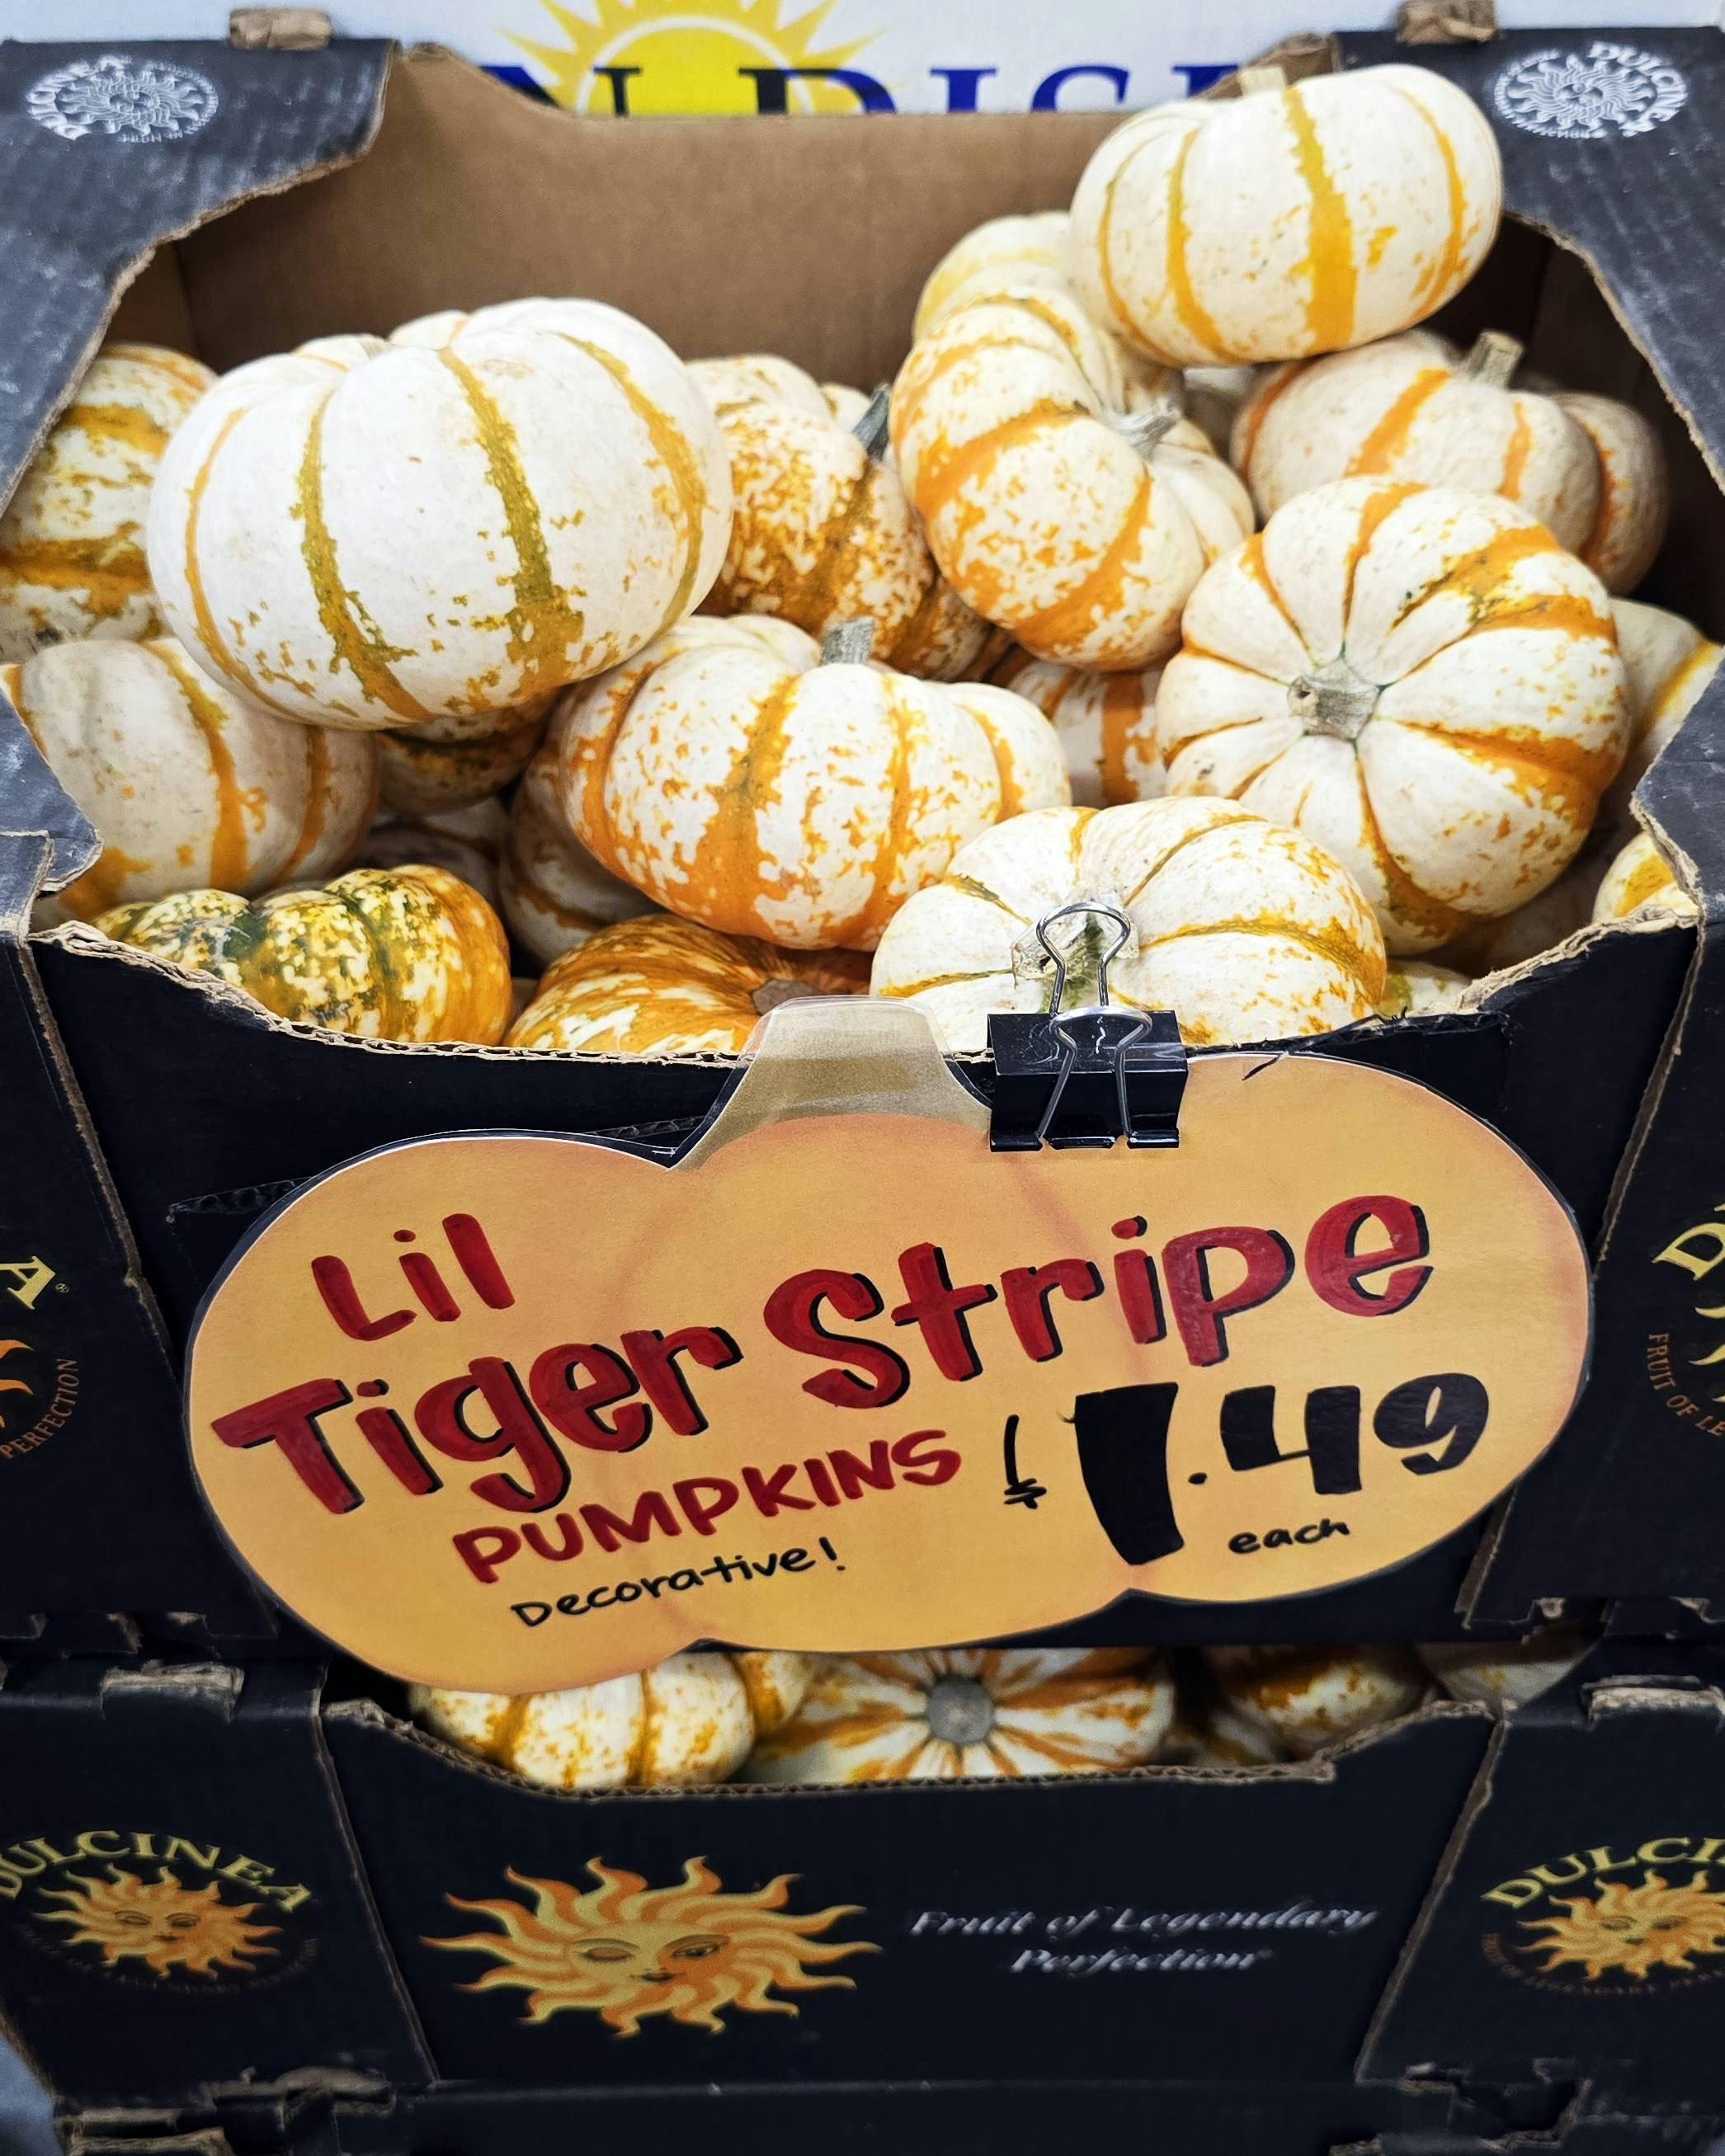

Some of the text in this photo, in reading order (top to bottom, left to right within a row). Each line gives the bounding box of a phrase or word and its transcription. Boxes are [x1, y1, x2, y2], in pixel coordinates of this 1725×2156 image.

[312, 1212, 515, 1341] Lil
[211, 1194, 1434, 1514] Tiger Stripe
[1647, 1333, 1676, 1391] FRUIT
[1666, 1395, 1699, 1417] OF
[0, 1358, 80, 1459] PERFECTION
[452, 1431, 962, 1584] PUMPKINS
[1228, 1518, 1350, 1556] each
[511, 1537, 846, 1626] Decorative!
[1480, 1837, 1725, 1910] DULCI
